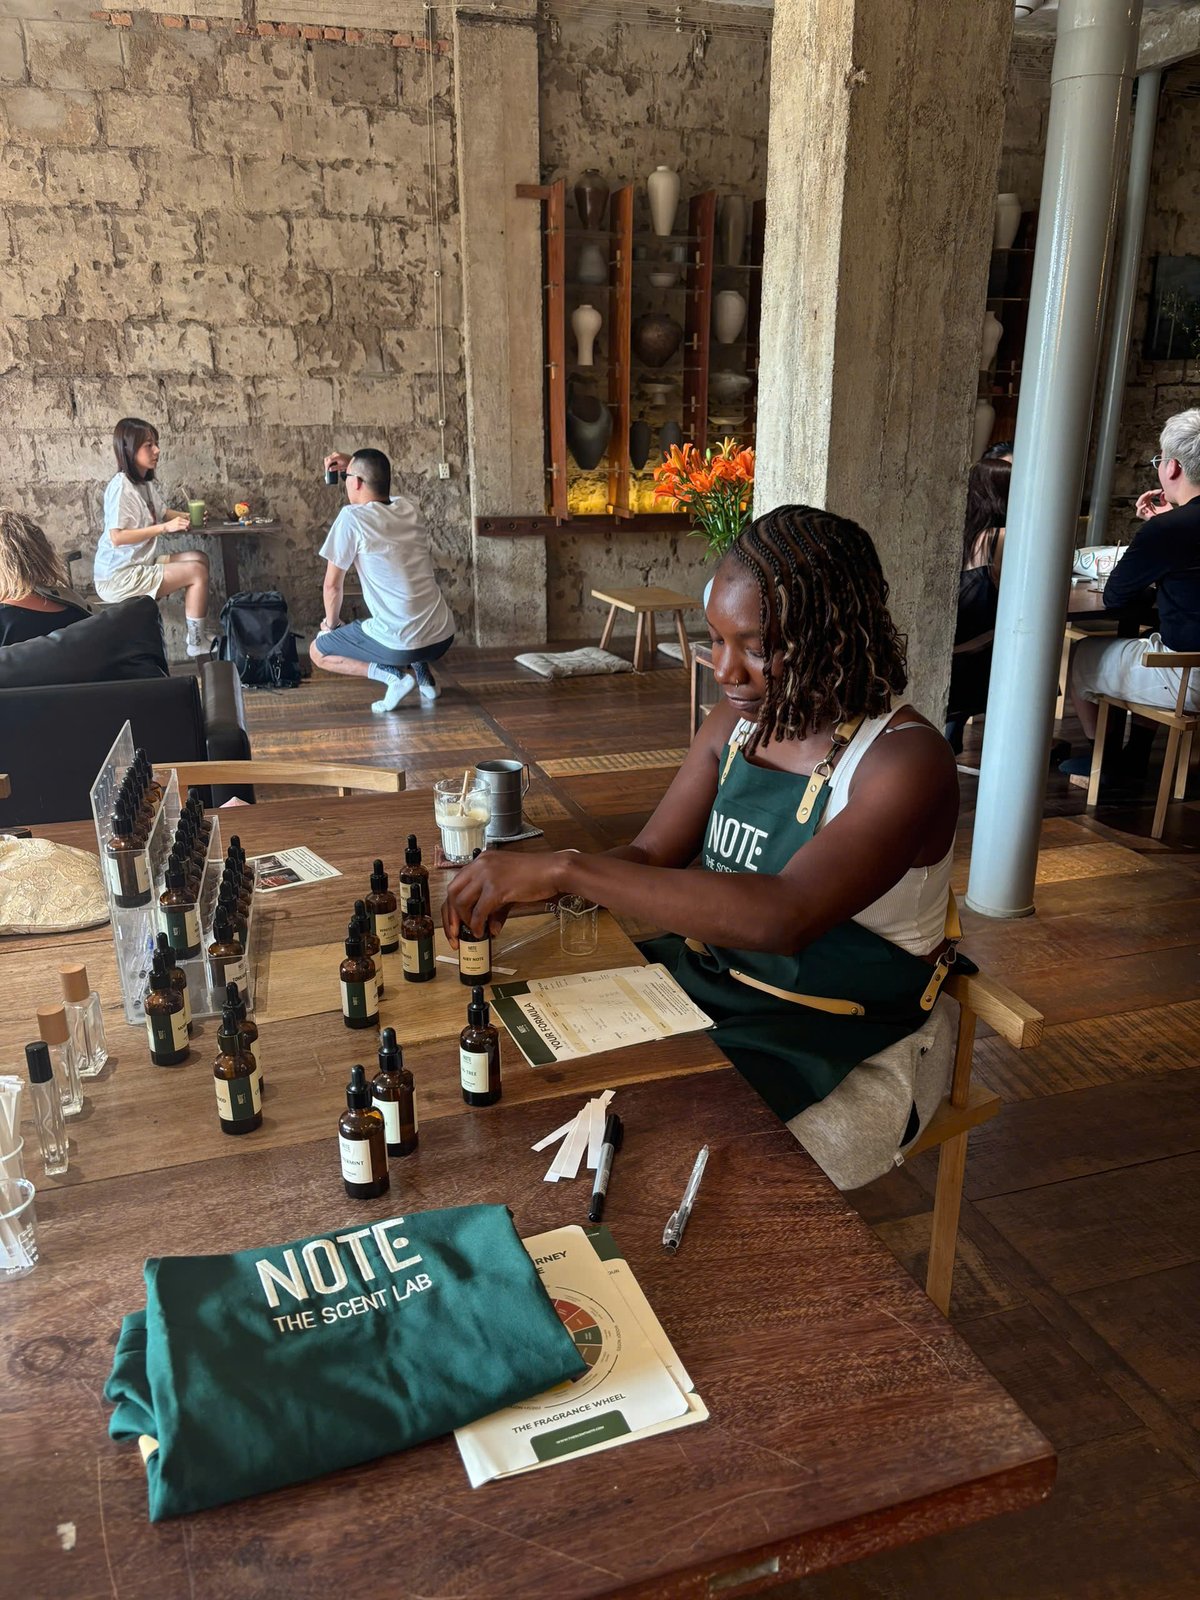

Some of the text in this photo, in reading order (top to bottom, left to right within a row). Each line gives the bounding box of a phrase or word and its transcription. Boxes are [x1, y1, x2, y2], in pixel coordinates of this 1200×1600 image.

[707, 810, 769, 872] NOTE
[523, 1002, 550, 1034] FORMULA
[544, 1029, 563, 1051] YOUR
[255, 1217, 423, 1309] NOTE
[534, 1250, 567, 1266] RNEY
[273, 1273, 433, 1333] THE SCENT LAB
[511, 1422, 533, 1434] THE
[533, 1403, 592, 1426] FRAGRANCE
[592, 1393, 627, 1408] WHEEL
